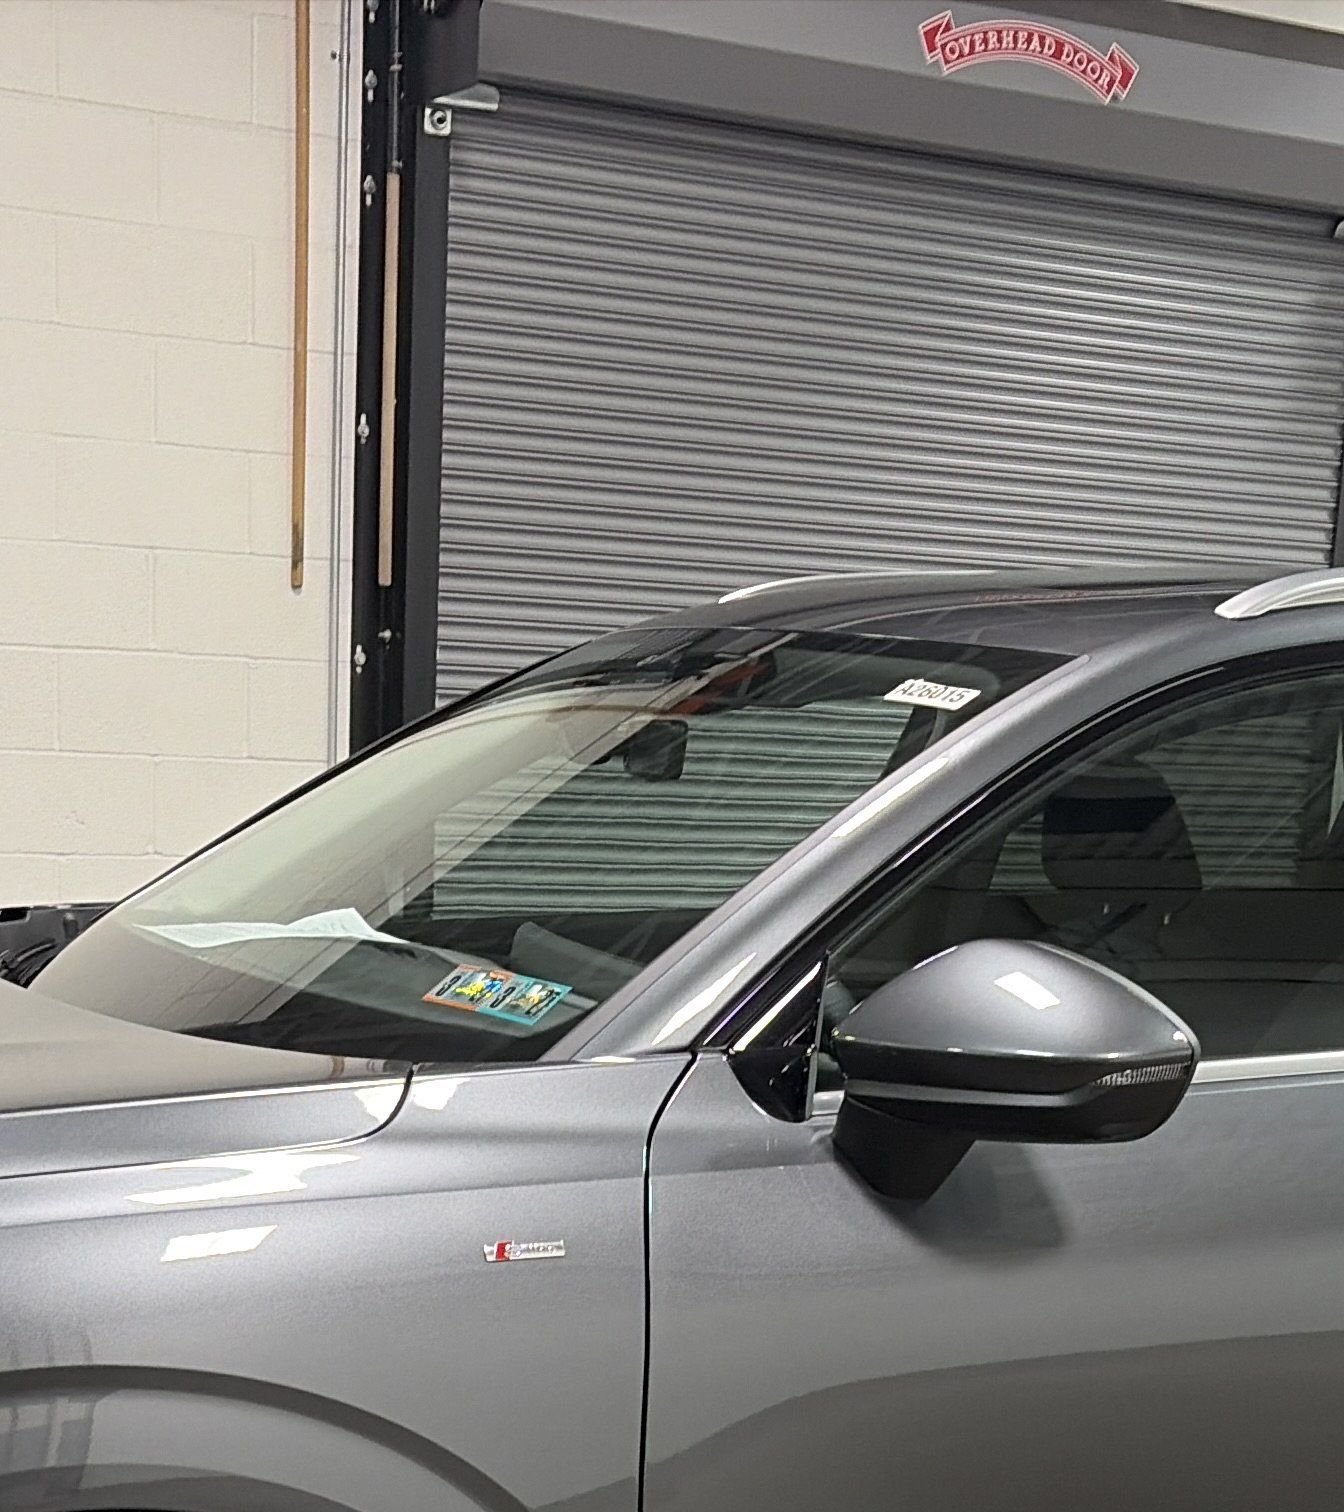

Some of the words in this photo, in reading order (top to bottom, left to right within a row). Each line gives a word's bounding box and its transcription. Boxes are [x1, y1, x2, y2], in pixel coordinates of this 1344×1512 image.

[944, 29, 1057, 61] OVERHEAD
[1061, 43, 1113, 92] DOOR
[894, 682, 971, 704] A26015
